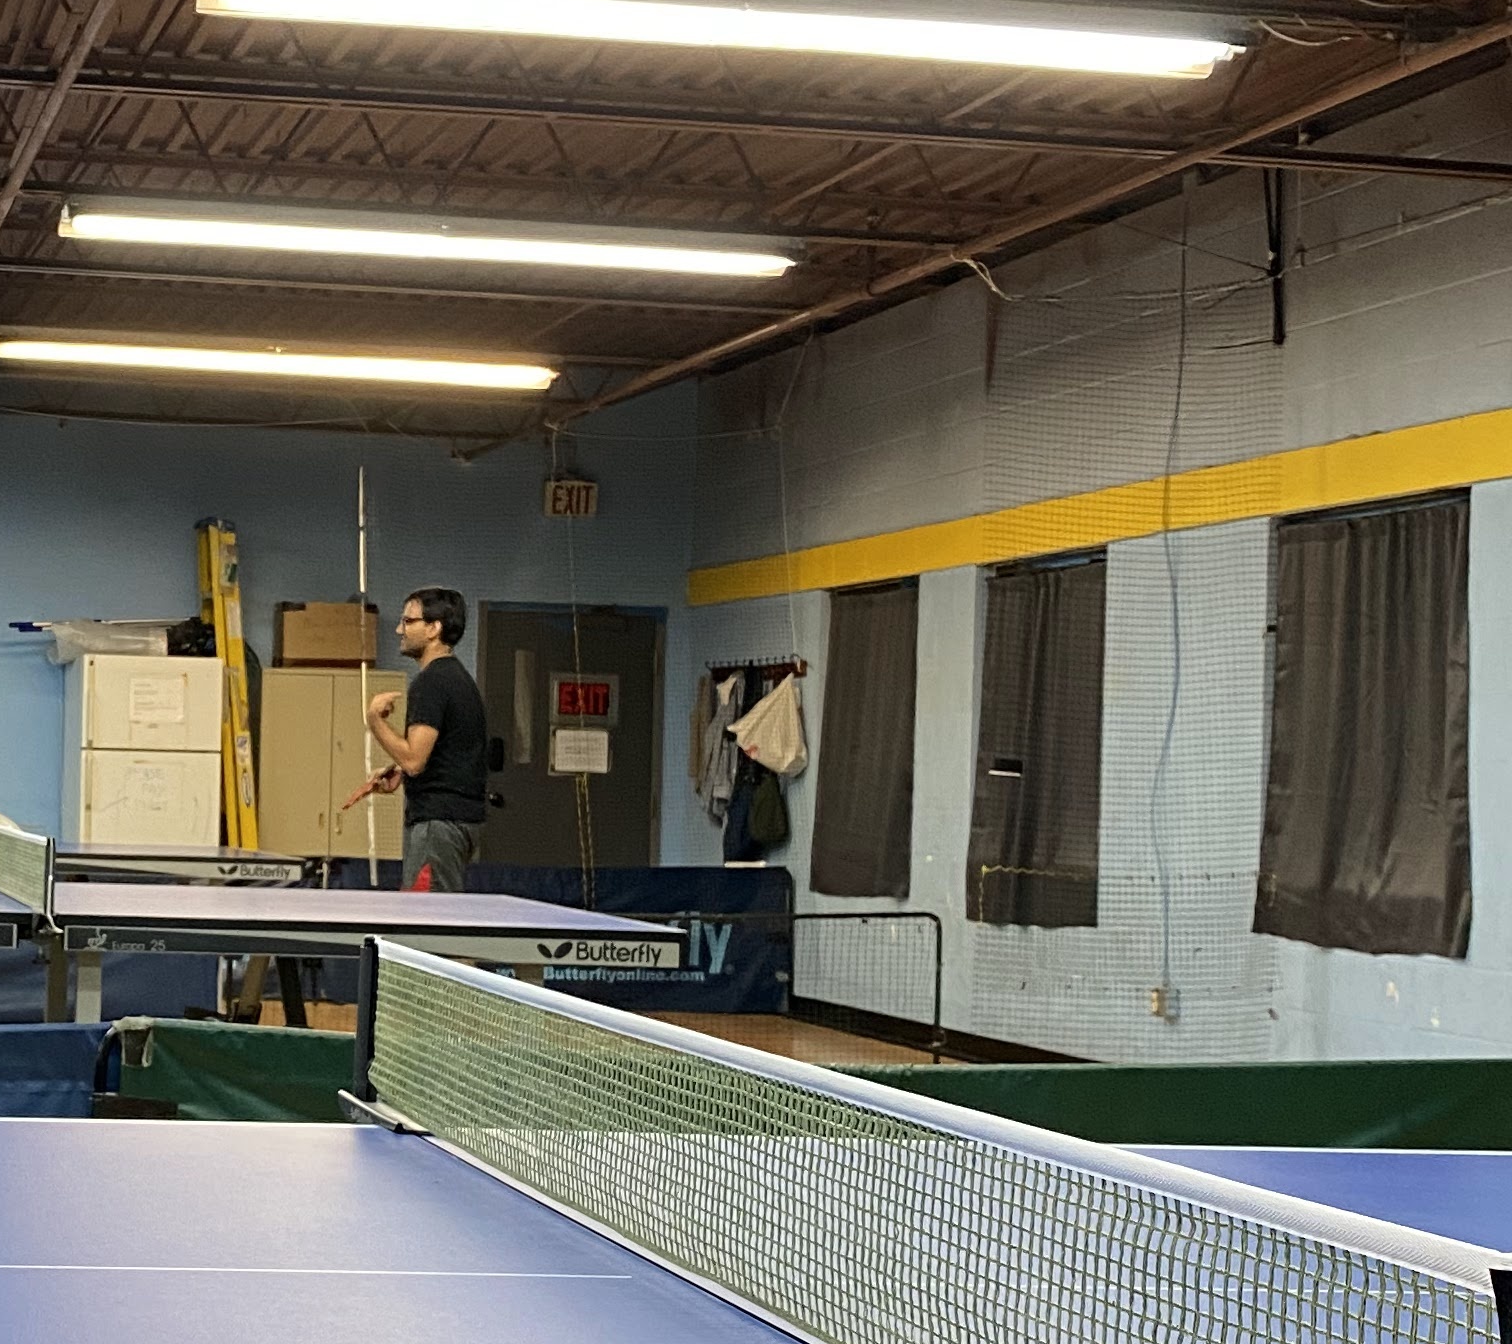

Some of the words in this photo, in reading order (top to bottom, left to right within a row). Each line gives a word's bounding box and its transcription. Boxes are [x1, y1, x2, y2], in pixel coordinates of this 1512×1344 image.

[552, 485, 594, 514] EXIT
[239, 863, 291, 879] Butterfly
[149, 939, 166, 952] 25
[575, 941, 662, 966] Butterfly
[543, 966, 705, 984] Butterflyonline.com
